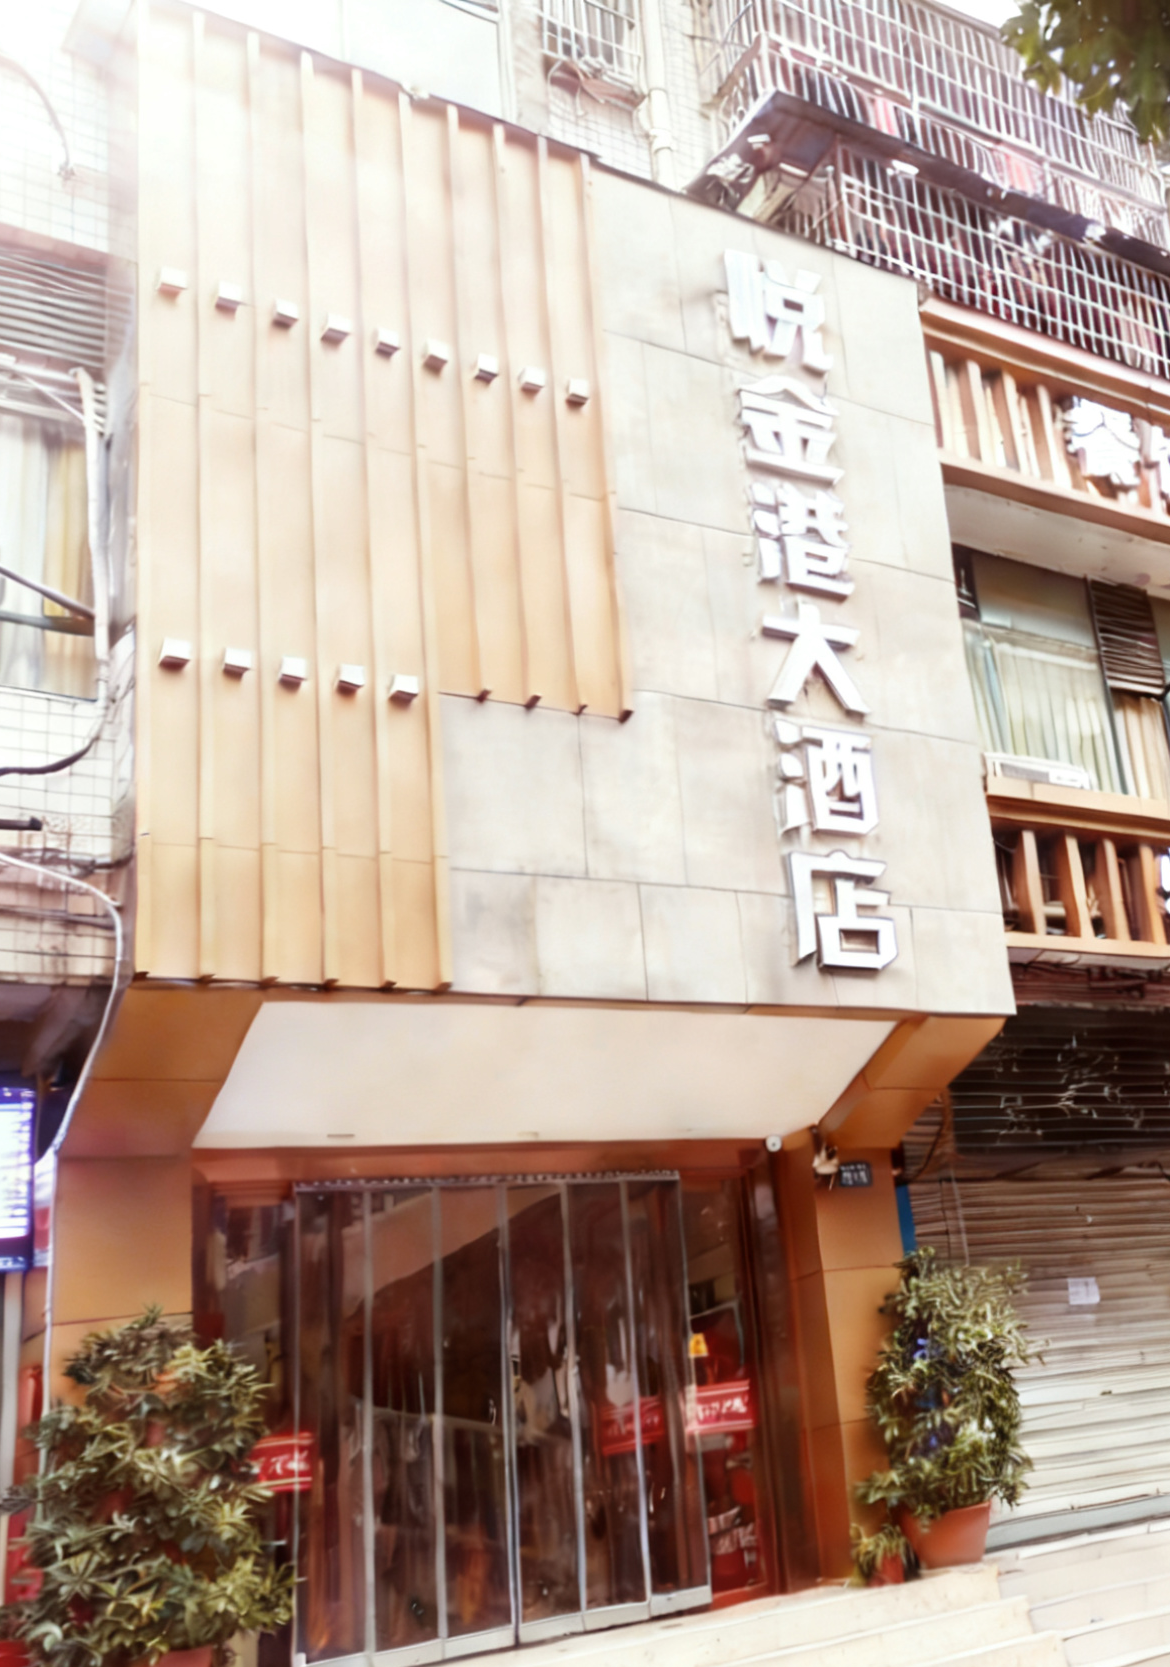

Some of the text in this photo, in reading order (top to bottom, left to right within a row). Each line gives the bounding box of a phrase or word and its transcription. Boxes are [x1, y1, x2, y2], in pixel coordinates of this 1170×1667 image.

[724, 248, 898, 973] 悦金港大酒店
